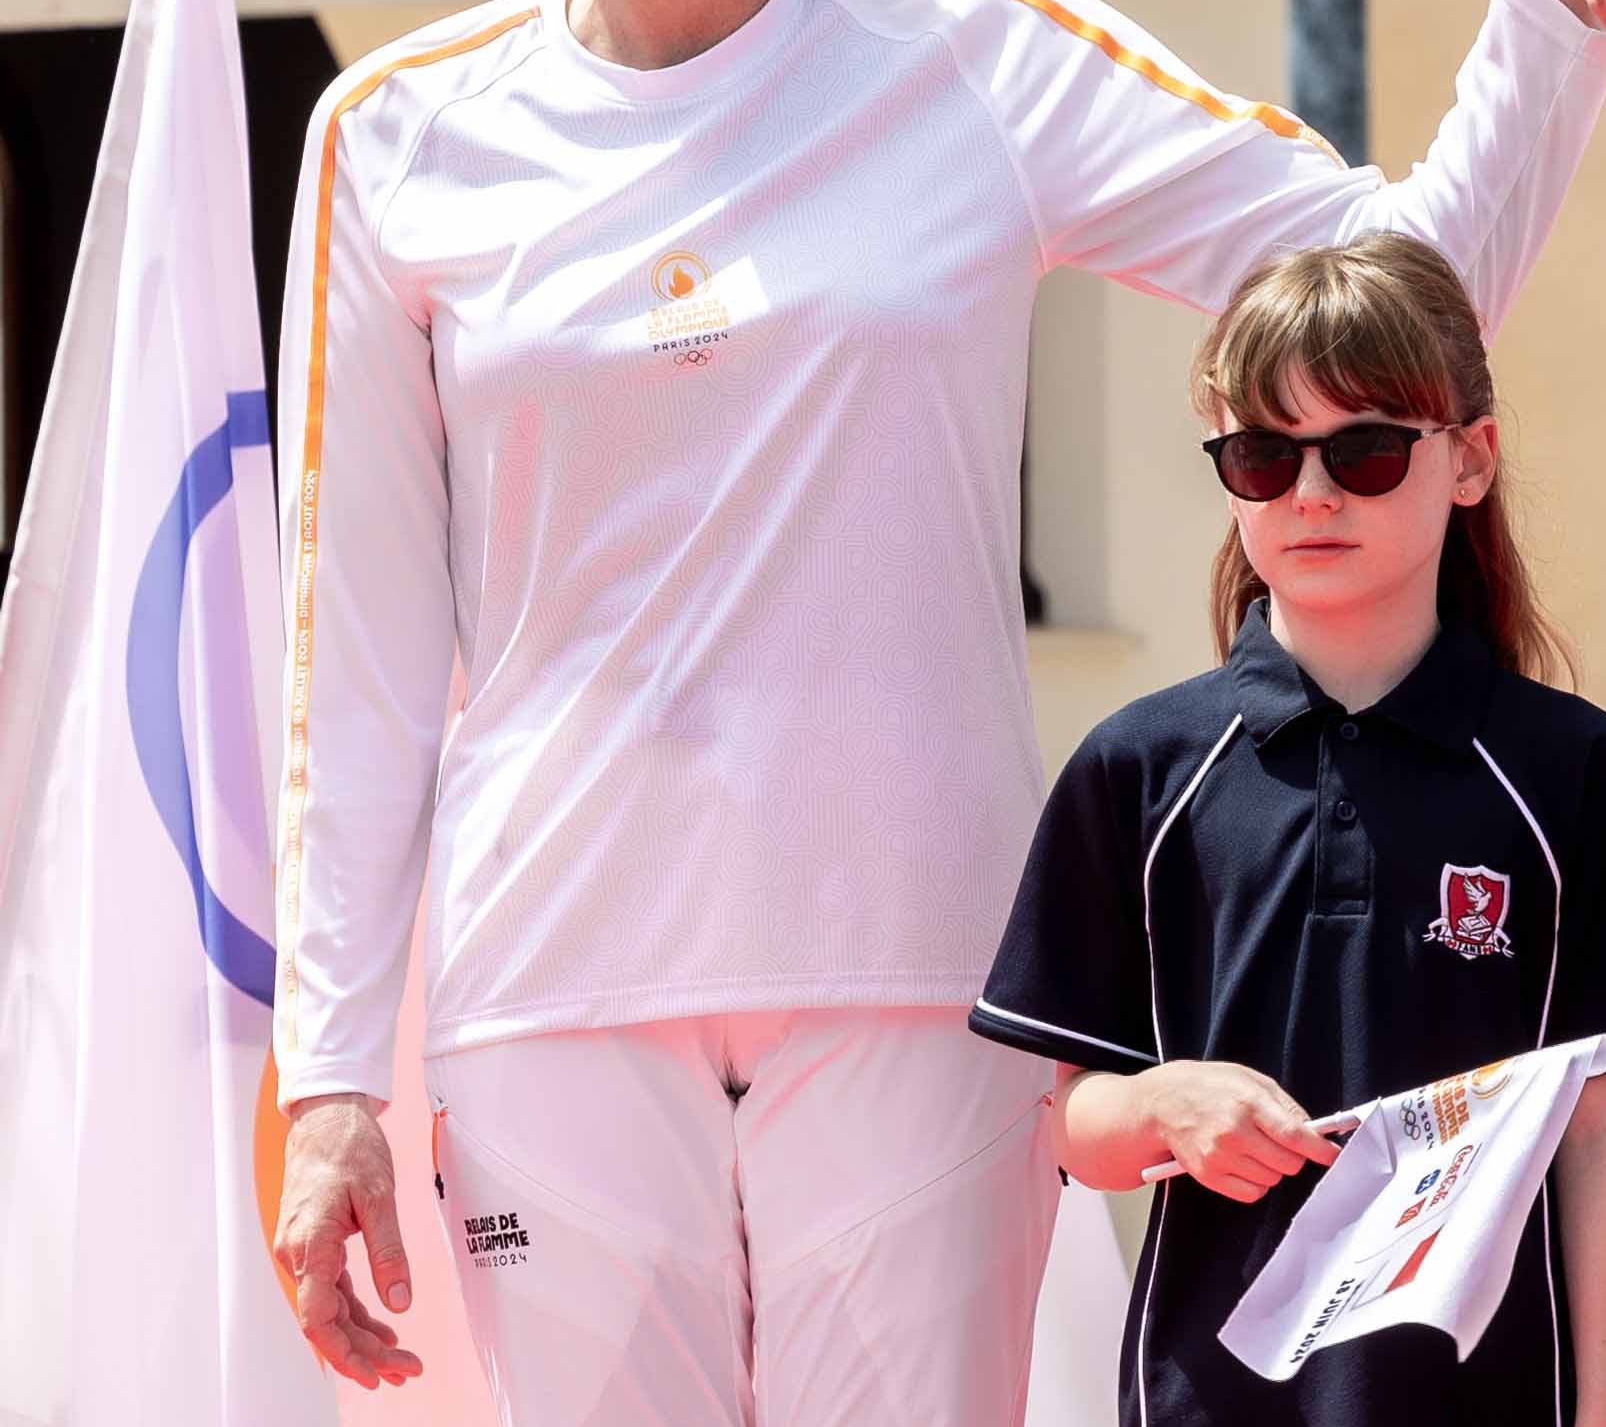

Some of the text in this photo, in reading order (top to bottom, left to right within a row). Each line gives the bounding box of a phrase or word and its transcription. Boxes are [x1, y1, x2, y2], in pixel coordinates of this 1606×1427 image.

[653, 332, 729, 352] PARIS 2024
[298, 630, 309, 663] 2024
[304, 470, 317, 504] 2024
[1421, 1112, 1435, 1150] 2024
[464, 1212, 519, 1236] RELAIS DE
[466, 1230, 530, 1254] LA FLAMME
[493, 1253, 527, 1267] 2024
[1336, 1278, 1356, 1294] 18
[1312, 1298, 1342, 1328] JUIN
[1289, 1331, 1320, 1363] 2024
